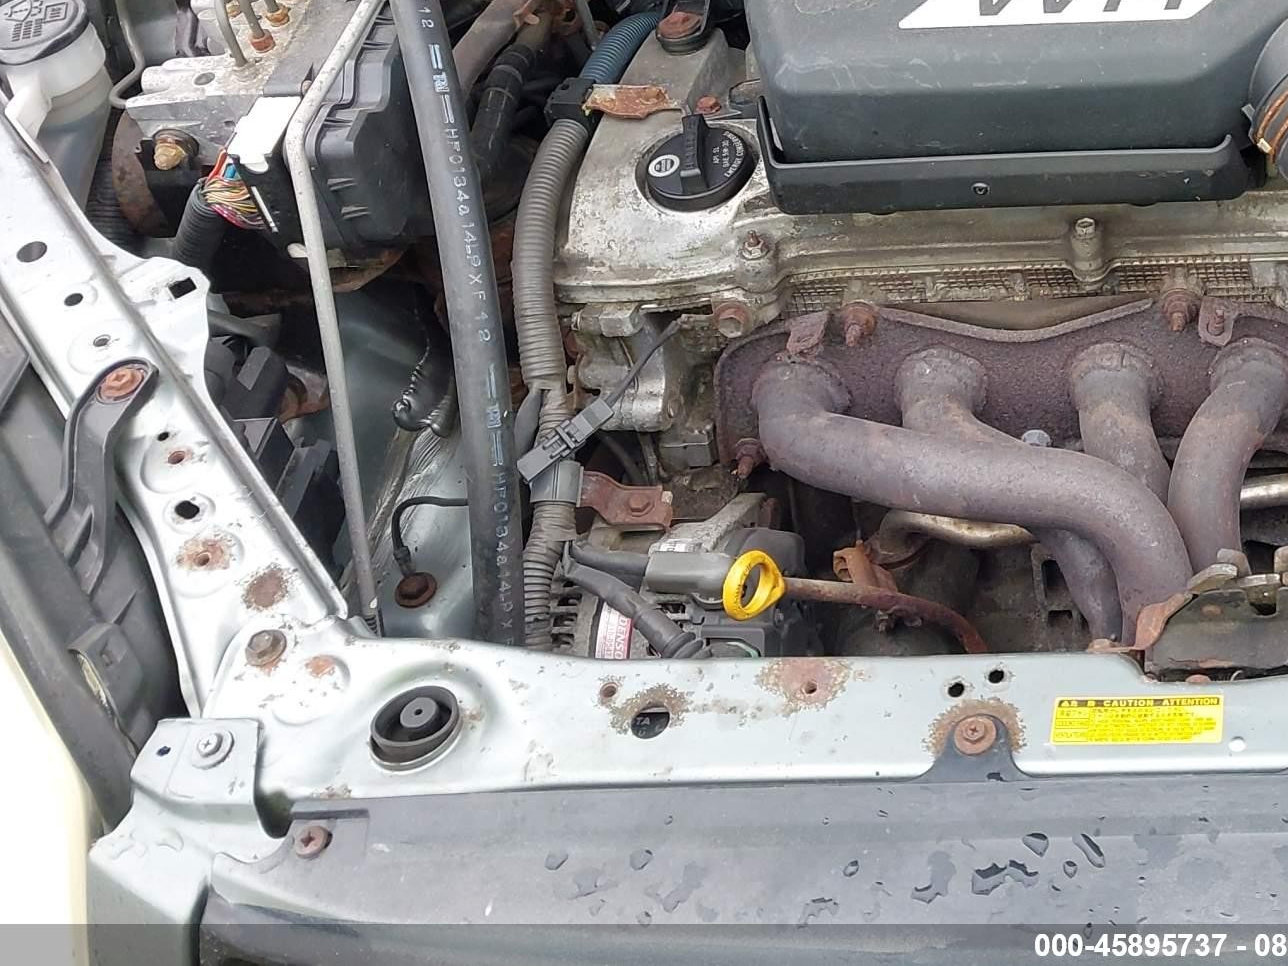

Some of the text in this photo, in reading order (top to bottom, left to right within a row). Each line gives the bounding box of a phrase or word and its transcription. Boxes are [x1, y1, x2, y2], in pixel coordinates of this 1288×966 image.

[614, 616, 627, 659] DENSO
[1103, 699, 1154, 707] CAUTION
[1162, 697, 1218, 706] ATTENTION
